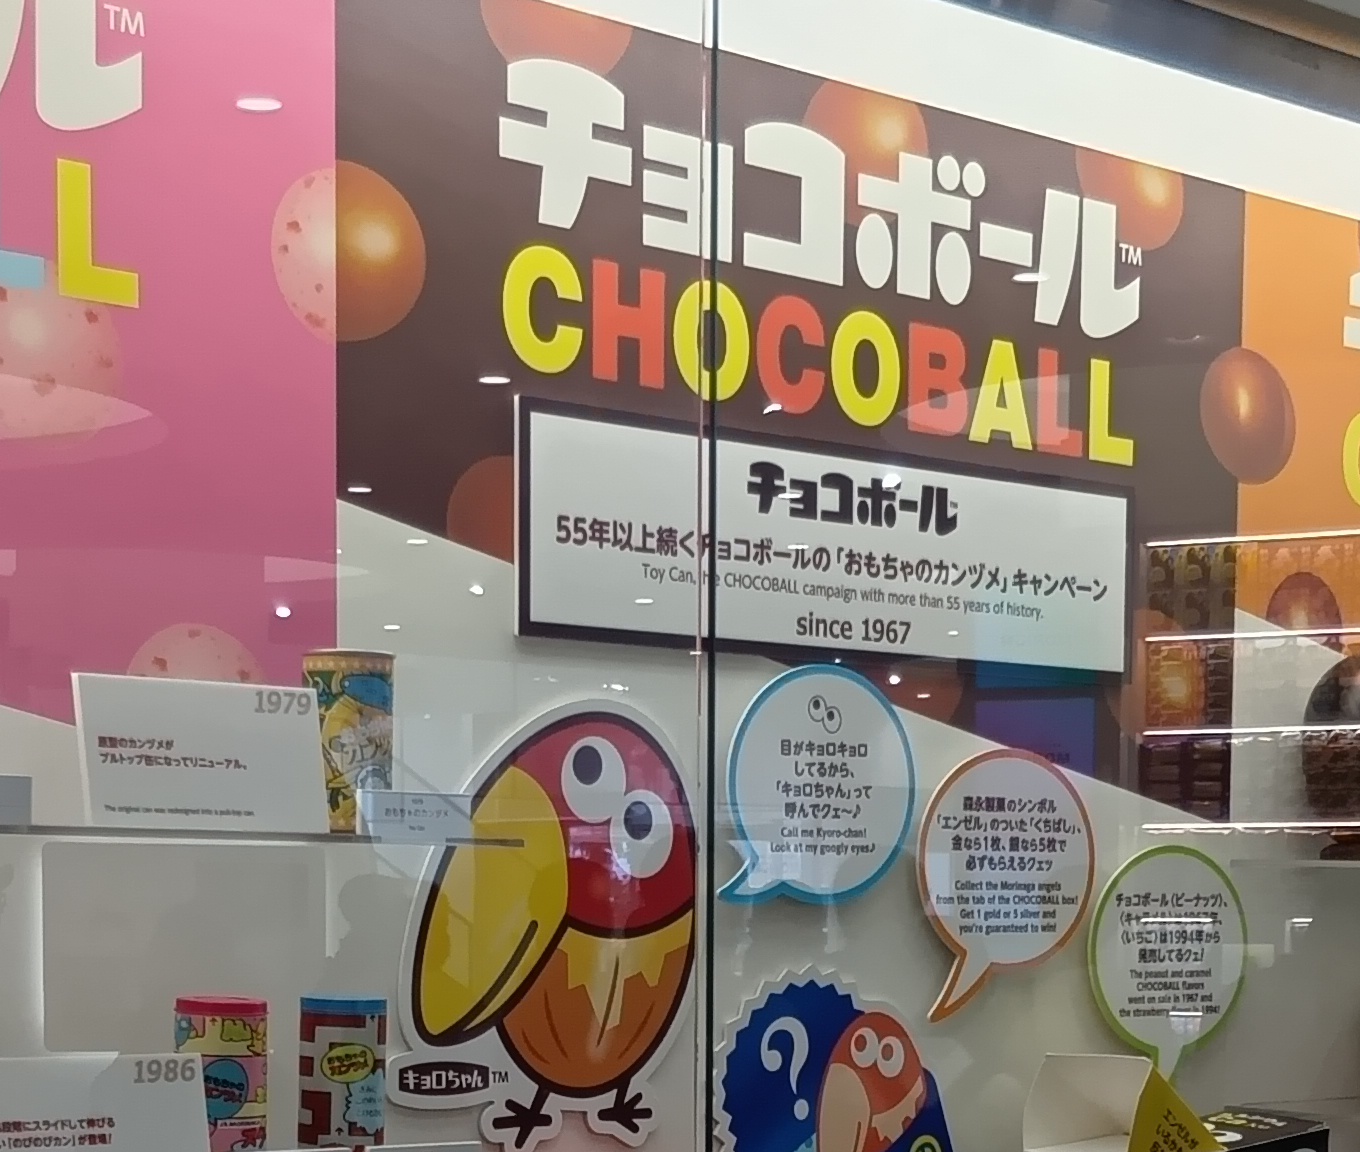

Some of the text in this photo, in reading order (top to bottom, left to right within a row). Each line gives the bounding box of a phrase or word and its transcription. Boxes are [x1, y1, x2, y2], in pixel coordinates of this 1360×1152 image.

[499, 58, 1140, 338] チョコボール
[503, 245, 1133, 466] CHOCOBALL
[747, 461, 958, 536] チョコボール
[642, 563, 1044, 621] Toy Can, CHOCOBALL campaign with more than 55 years of history.
[796, 611, 912, 645] since 1967
[254, 690, 311, 716] 1979
[780, 739, 868, 758] 目がキョロキョロ
[794, 761, 855, 778] してるから、
[776, 780, 873, 800] 「キョロちゃん」って
[963, 796, 1057, 814] 森永製菓のシンボル
[937, 815, 1081, 834] 「エンゼル」のついた「くちばし」、
[781, 827, 867, 841] Call me Kyoro-chan!
[951, 834, 1067, 852] 金なら1枚、銀なら5枚で
[770, 842, 848, 856] Look at my googly
[955, 880, 1061, 893] Collect the Morinaga angels
[936, 894, 1078, 906] from the tab of the CHOCOBALL box!
[960, 909, 974, 919] Get
[984, 909, 1001, 921] gold
[1003, 910, 1011, 919] or
[1020, 909, 1040, 919] silver
[1042, 909, 1056, 919] and
[959, 924, 983, 936] you're
[985, 924, 1028, 936] guaranteed
[1031, 924, 1039, 933] to
[1130, 970, 1142, 979] The
[1137, 981, 1179, 991] CHOCOBALL
[133, 1059, 196, 1084] 1986
[403, 1070, 484, 1090] キョロちゃん
